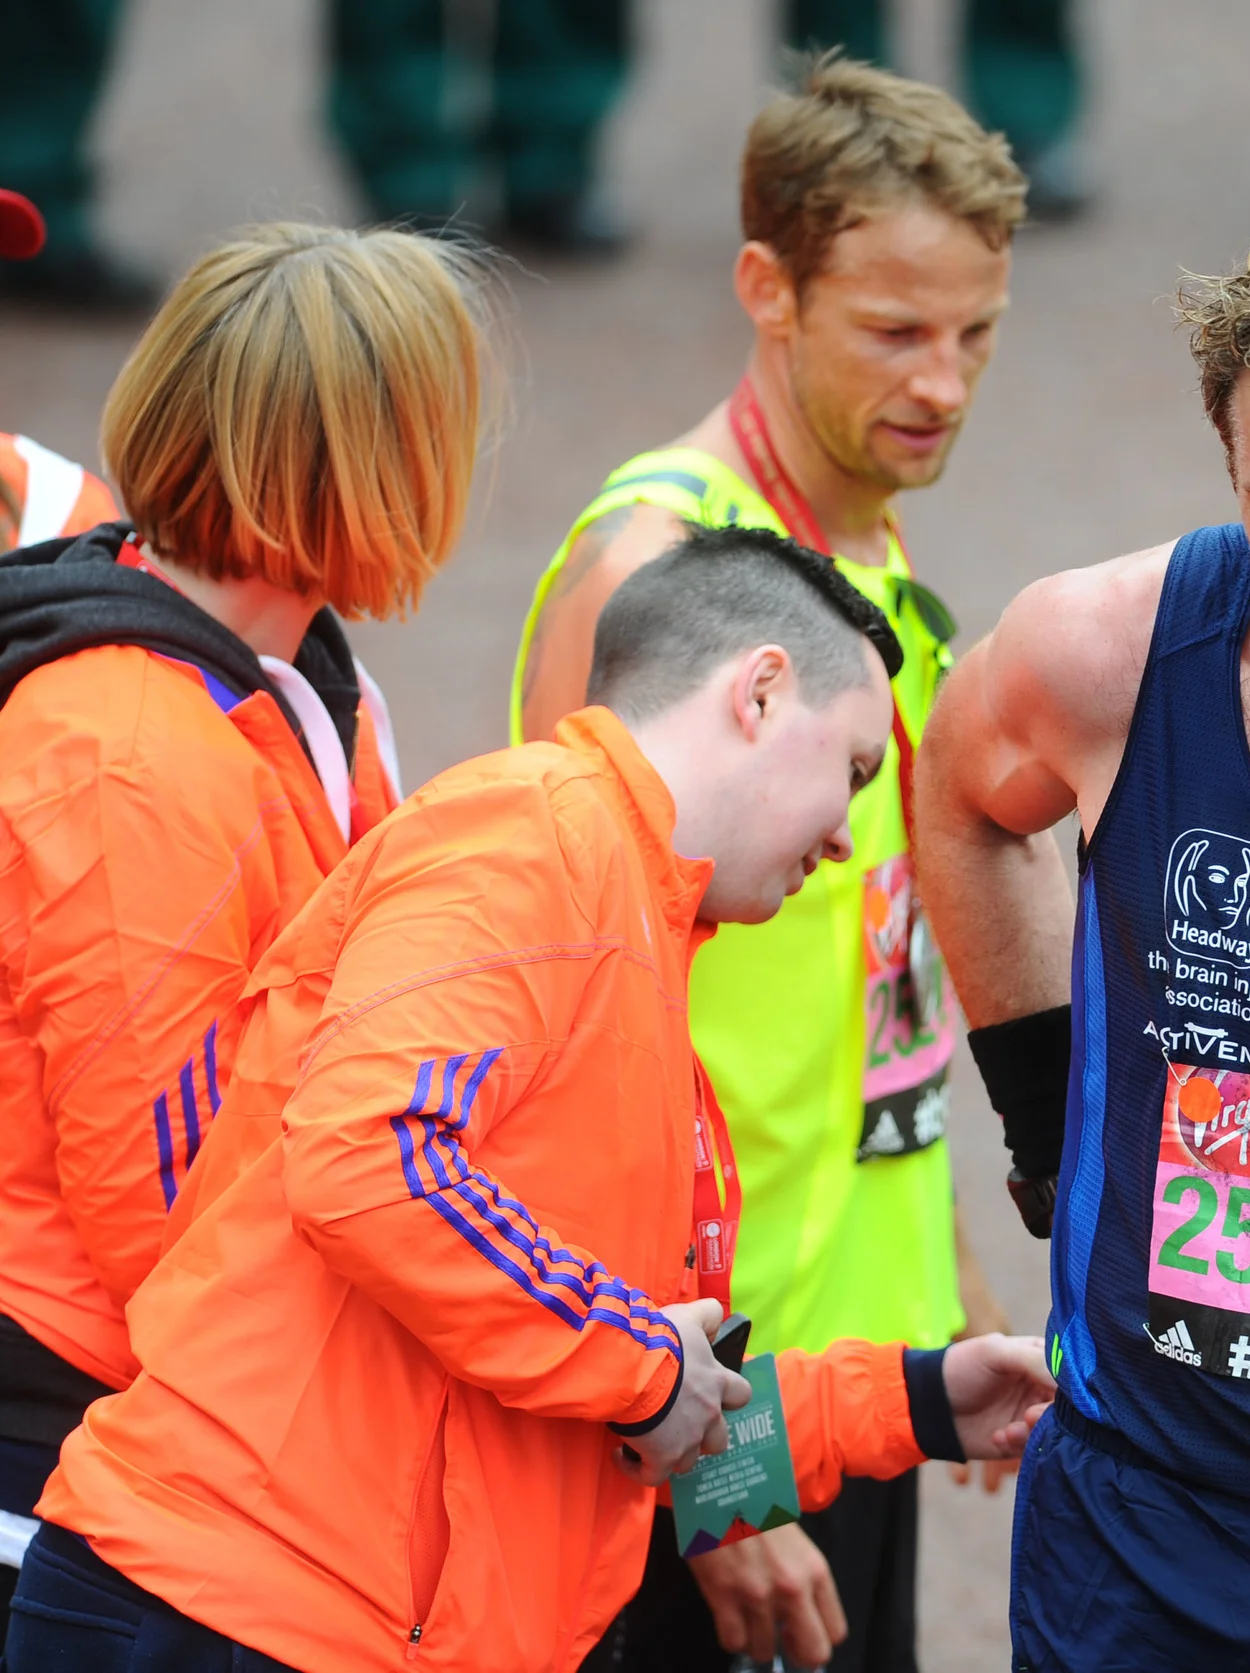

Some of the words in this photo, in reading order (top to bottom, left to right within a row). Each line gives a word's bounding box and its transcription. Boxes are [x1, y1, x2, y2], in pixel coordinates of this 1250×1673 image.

[1148, 950, 1170, 974] th
[1175, 958, 1228, 987] brain
[1155, 1343, 1202, 1367] adidas
[734, 1410, 776, 1446] WIDE
